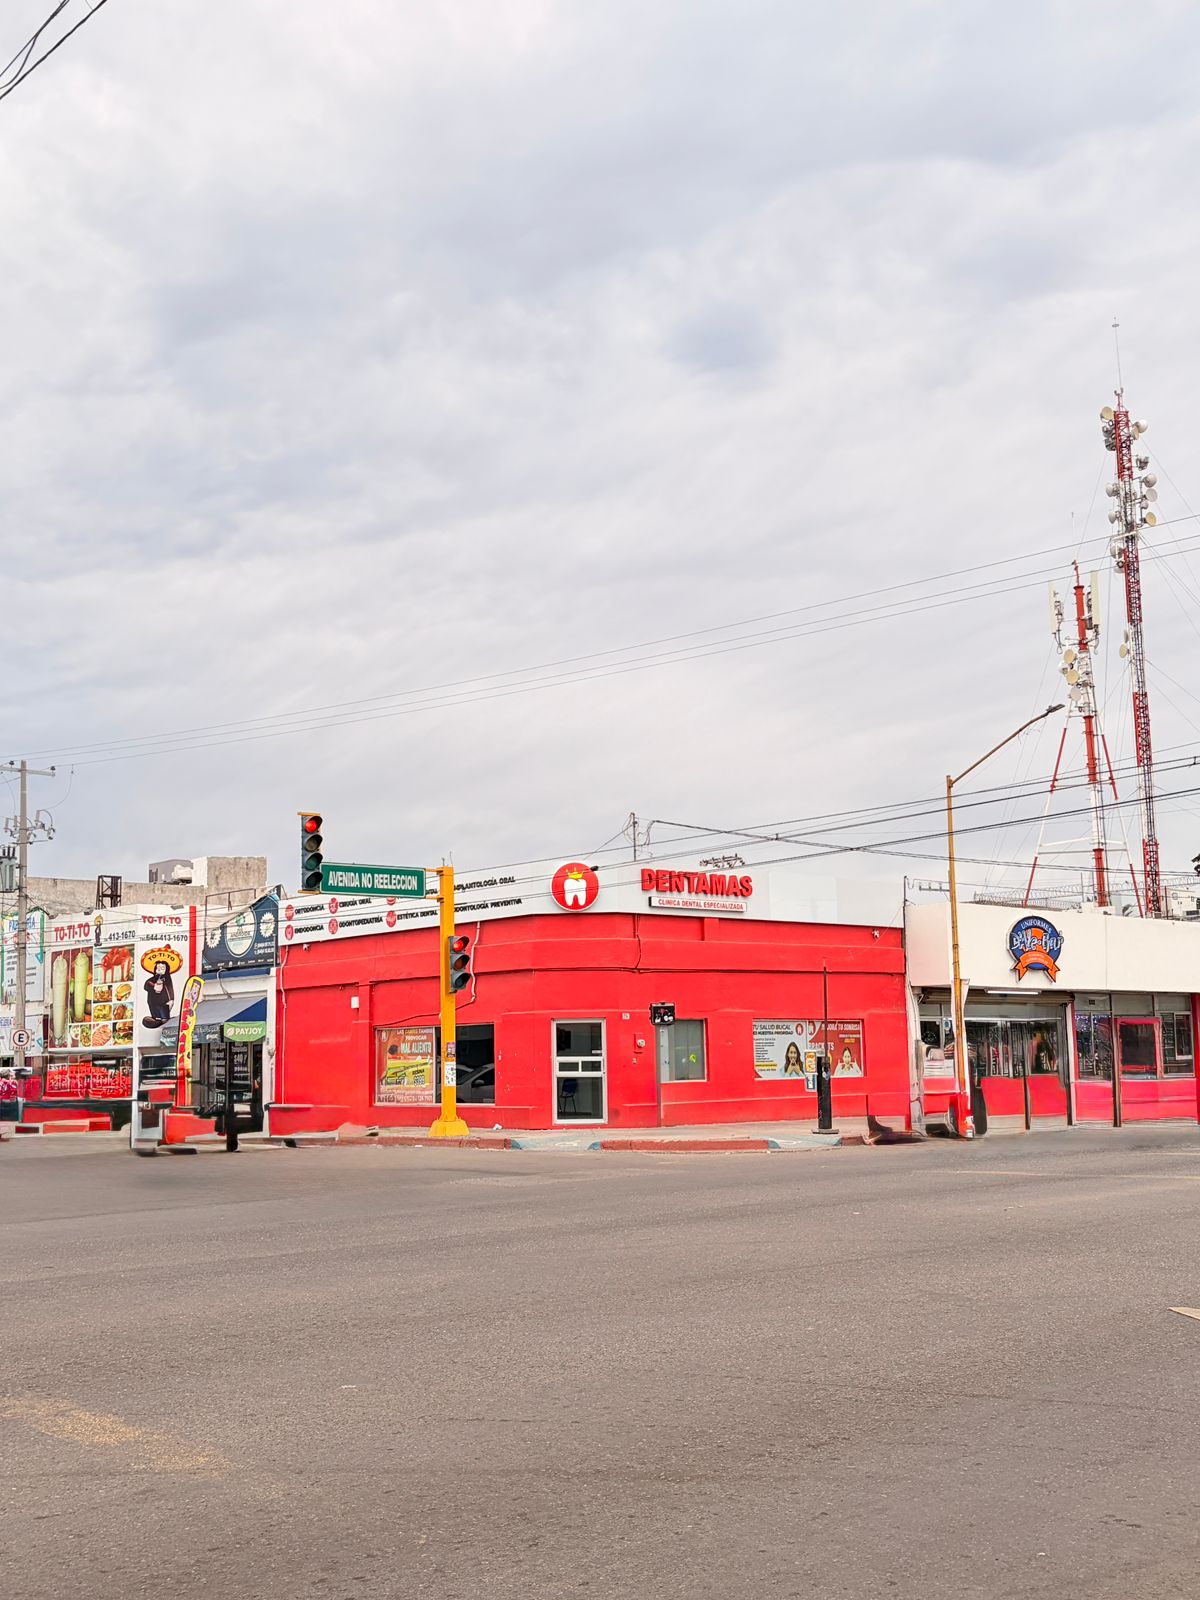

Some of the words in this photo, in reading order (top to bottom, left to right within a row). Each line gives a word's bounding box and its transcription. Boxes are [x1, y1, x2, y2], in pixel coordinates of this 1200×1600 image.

[328, 870, 360, 887] AVENIDA
[361, 873, 373, 888] NO
[374, 874, 418, 890] REELECCION
[453, 877, 498, 891] MPLANTOLOGÍA
[499, 876, 516, 885] ORAL
[641, 868, 753, 897] DENTAMAS
[339, 898, 358, 908] CIRUGÍA
[358, 897, 371, 905] ORAL
[490, 898, 523, 909] PREVENTIVA
[681, 900, 703, 908] DENTAL
[703, 902, 744, 910] ESPECIALIZADA
[294, 904, 325, 915] ORTODONCIA
[397, 911, 419, 920] ESTÉTICA
[420, 909, 438, 917] DENTAL
[141, 915, 182, 924] TO-TI-TO
[339, 915, 383, 928] ODONTOPEDIATRÍA
[294, 924, 324, 934] ENDODONCIA
[1020, 918, 1053, 934] UNIFORMES
[108, 930, 136, 941] 413-1670
[148, 952, 176, 962] TO-TI-TO
[235, 1027, 263, 1035] PAYJOY
[18, 1033, 25, 1043] E
[808, 1042, 835, 1051] BRACKTS
